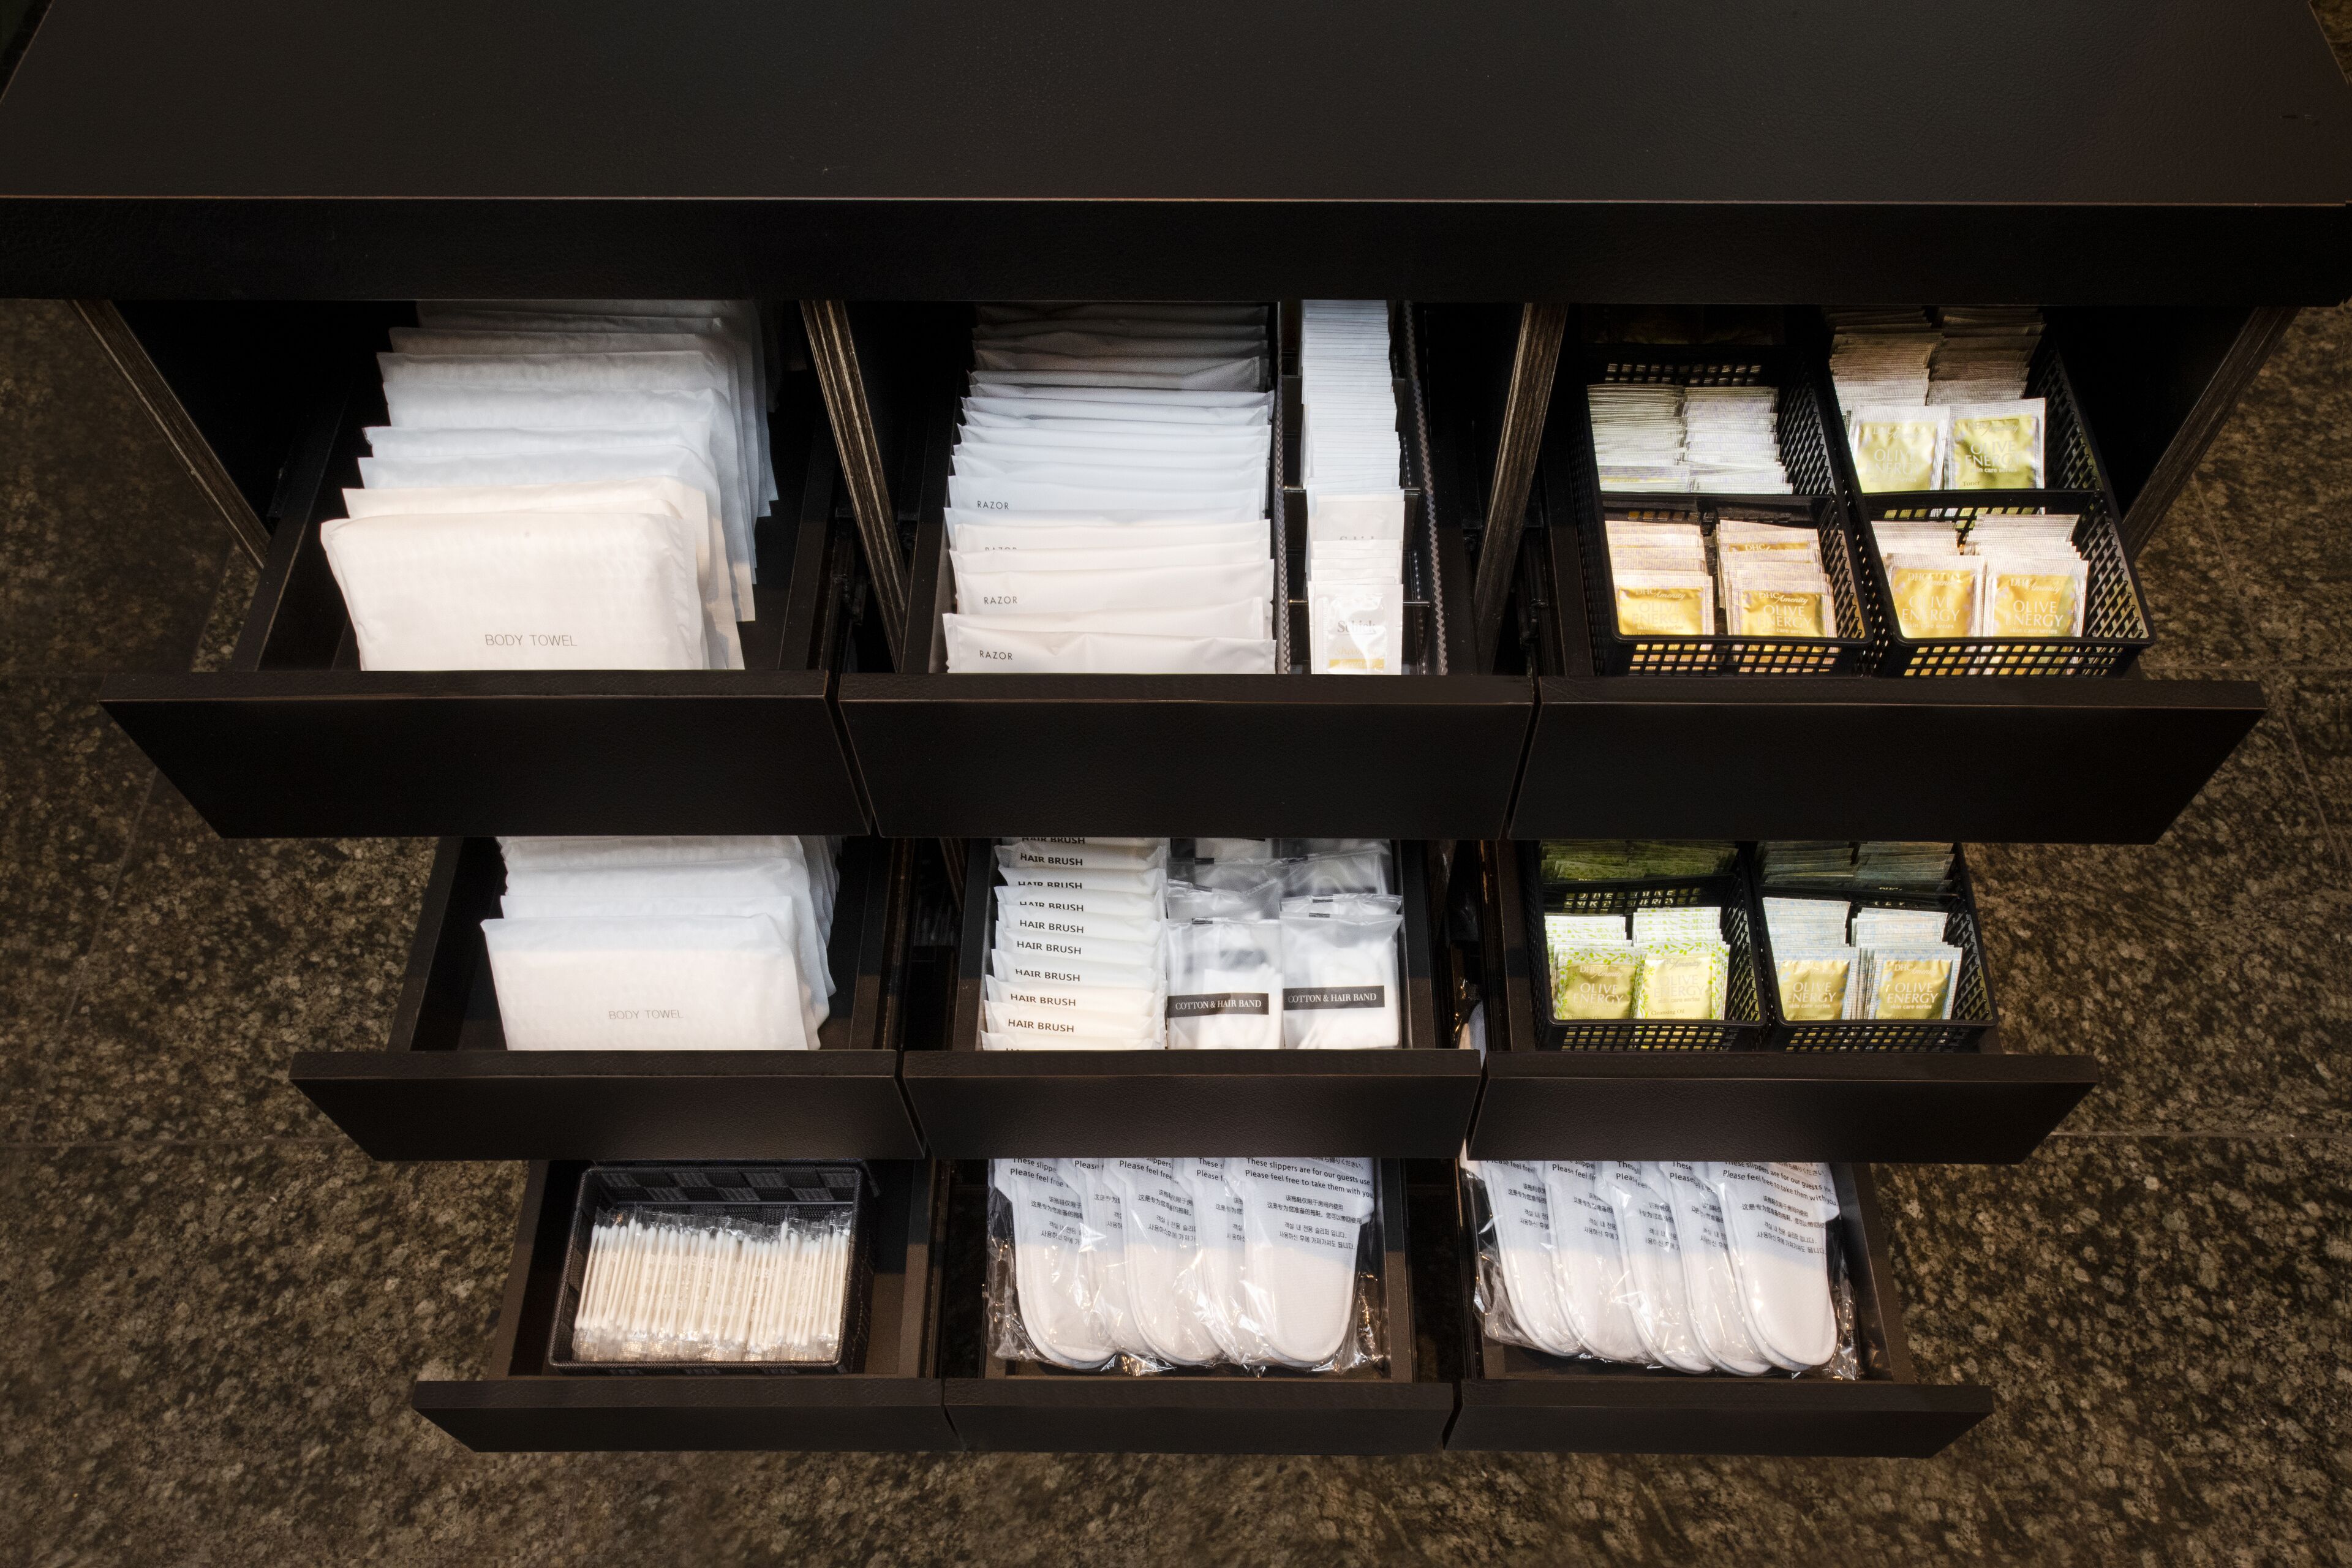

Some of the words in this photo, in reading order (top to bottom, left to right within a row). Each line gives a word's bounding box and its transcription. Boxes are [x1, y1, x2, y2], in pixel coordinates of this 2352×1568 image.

[1970, 441, 2016, 454] OLIVE
[1873, 449, 1915, 461] OLIVE
[1965, 453, 2020, 469] ENERGY
[977, 500, 1009, 510] RAZOR
[1635, 586, 1657, 595] DHC
[1654, 591, 1686, 601] Amenity
[983, 596, 1018, 605] RAZOR
[1773, 595, 1809, 605] Amenity
[1909, 596, 1951, 608] OLIVE
[1638, 601, 1681, 613] OLIVE
[1763, 605, 1805, 616] OLIVE
[2013, 600, 2057, 613] OLIVE
[1632, 613, 1686, 625] ENERGY
[1902, 608, 1960, 622] ENERGY
[2005, 613, 2064, 627] ENERGY
[1757, 616, 1812, 628] ENERGY
[485, 634, 523, 646] BODY
[529, 635, 578, 646] TOWEL
[980, 650, 1012, 660] RAZOR
[1020, 853, 1045, 863] HAIR
[1048, 857, 1083, 865] BRUSH
[1049, 903, 1084, 911] BRUSH
[1019, 919, 1046, 929] HAIR
[1049, 923, 1084, 933] BRUSH
[1017, 940, 1042, 950] HAIR
[1046, 944, 1082, 955] BRUSH
[1015, 968, 1041, 978] HAIR
[1045, 971, 1080, 982] BRUSH
[1659, 974, 1698, 986] OLIVE
[1580, 982, 1618, 995] OLIVE
[1654, 985, 1705, 998] ENERGY
[1793, 981, 1832, 993] OLIVE
[1894, 982, 1933, 993] OLIVE
[1011, 993, 1036, 1003] HAIR
[1040, 997, 1076, 1006] BRUSH
[1288, 994, 1321, 1003] COTTON
[1331, 993, 1351, 1002] HAIR
[1353, 993, 1376, 1001] BAND
[1573, 993, 1624, 1005] ENERGY
[1785, 992, 1836, 1003] ENERGY
[1887, 992, 1939, 1004] ENERGY
[1175, 1001, 1208, 1010] COTTON
[1217, 1000, 1237, 1008] HAIR
[608, 1011, 639, 1020] BODY
[644, 1009, 684, 1019] TOWEL
[1008, 1019, 1034, 1028] HAIR
[1038, 1022, 1074, 1033] BRUSH
[1199, 1158, 1218, 1168] These
[1673, 1161, 1692, 1170] These
[1119, 1160, 1145, 1170] Please
[1147, 1166, 1158, 1175] feel
[1161, 1170, 1172, 1181] free
[1197, 1169, 1219, 1181] Please
[1247, 1158, 1267, 1167] These
[1270, 1161, 1297, 1172] slippers
[1337, 1174, 1359, 1183] guests
[1575, 1170, 1588, 1179] feel
[1746, 1162, 1770, 1175] slippers
[1781, 1173, 1789, 1182] for
[1802, 1181, 1822, 1191] guests
[1010, 1169, 1035, 1178] Please
[1036, 1173, 1049, 1183] feel
[1050, 1178, 1064, 1187] free
[1245, 1169, 1269, 1178] Please
[1271, 1173, 1284, 1182] feel
[1328, 1183, 1344, 1192] them
[1670, 1172, 1694, 1183] Please
[1723, 1170, 1746, 1180] Please
[1747, 1173, 1761, 1182] feel
[1762, 1177, 1773, 1186] free
[1781, 1185, 1793, 1194] take
[1795, 1189, 1807, 1200] them
